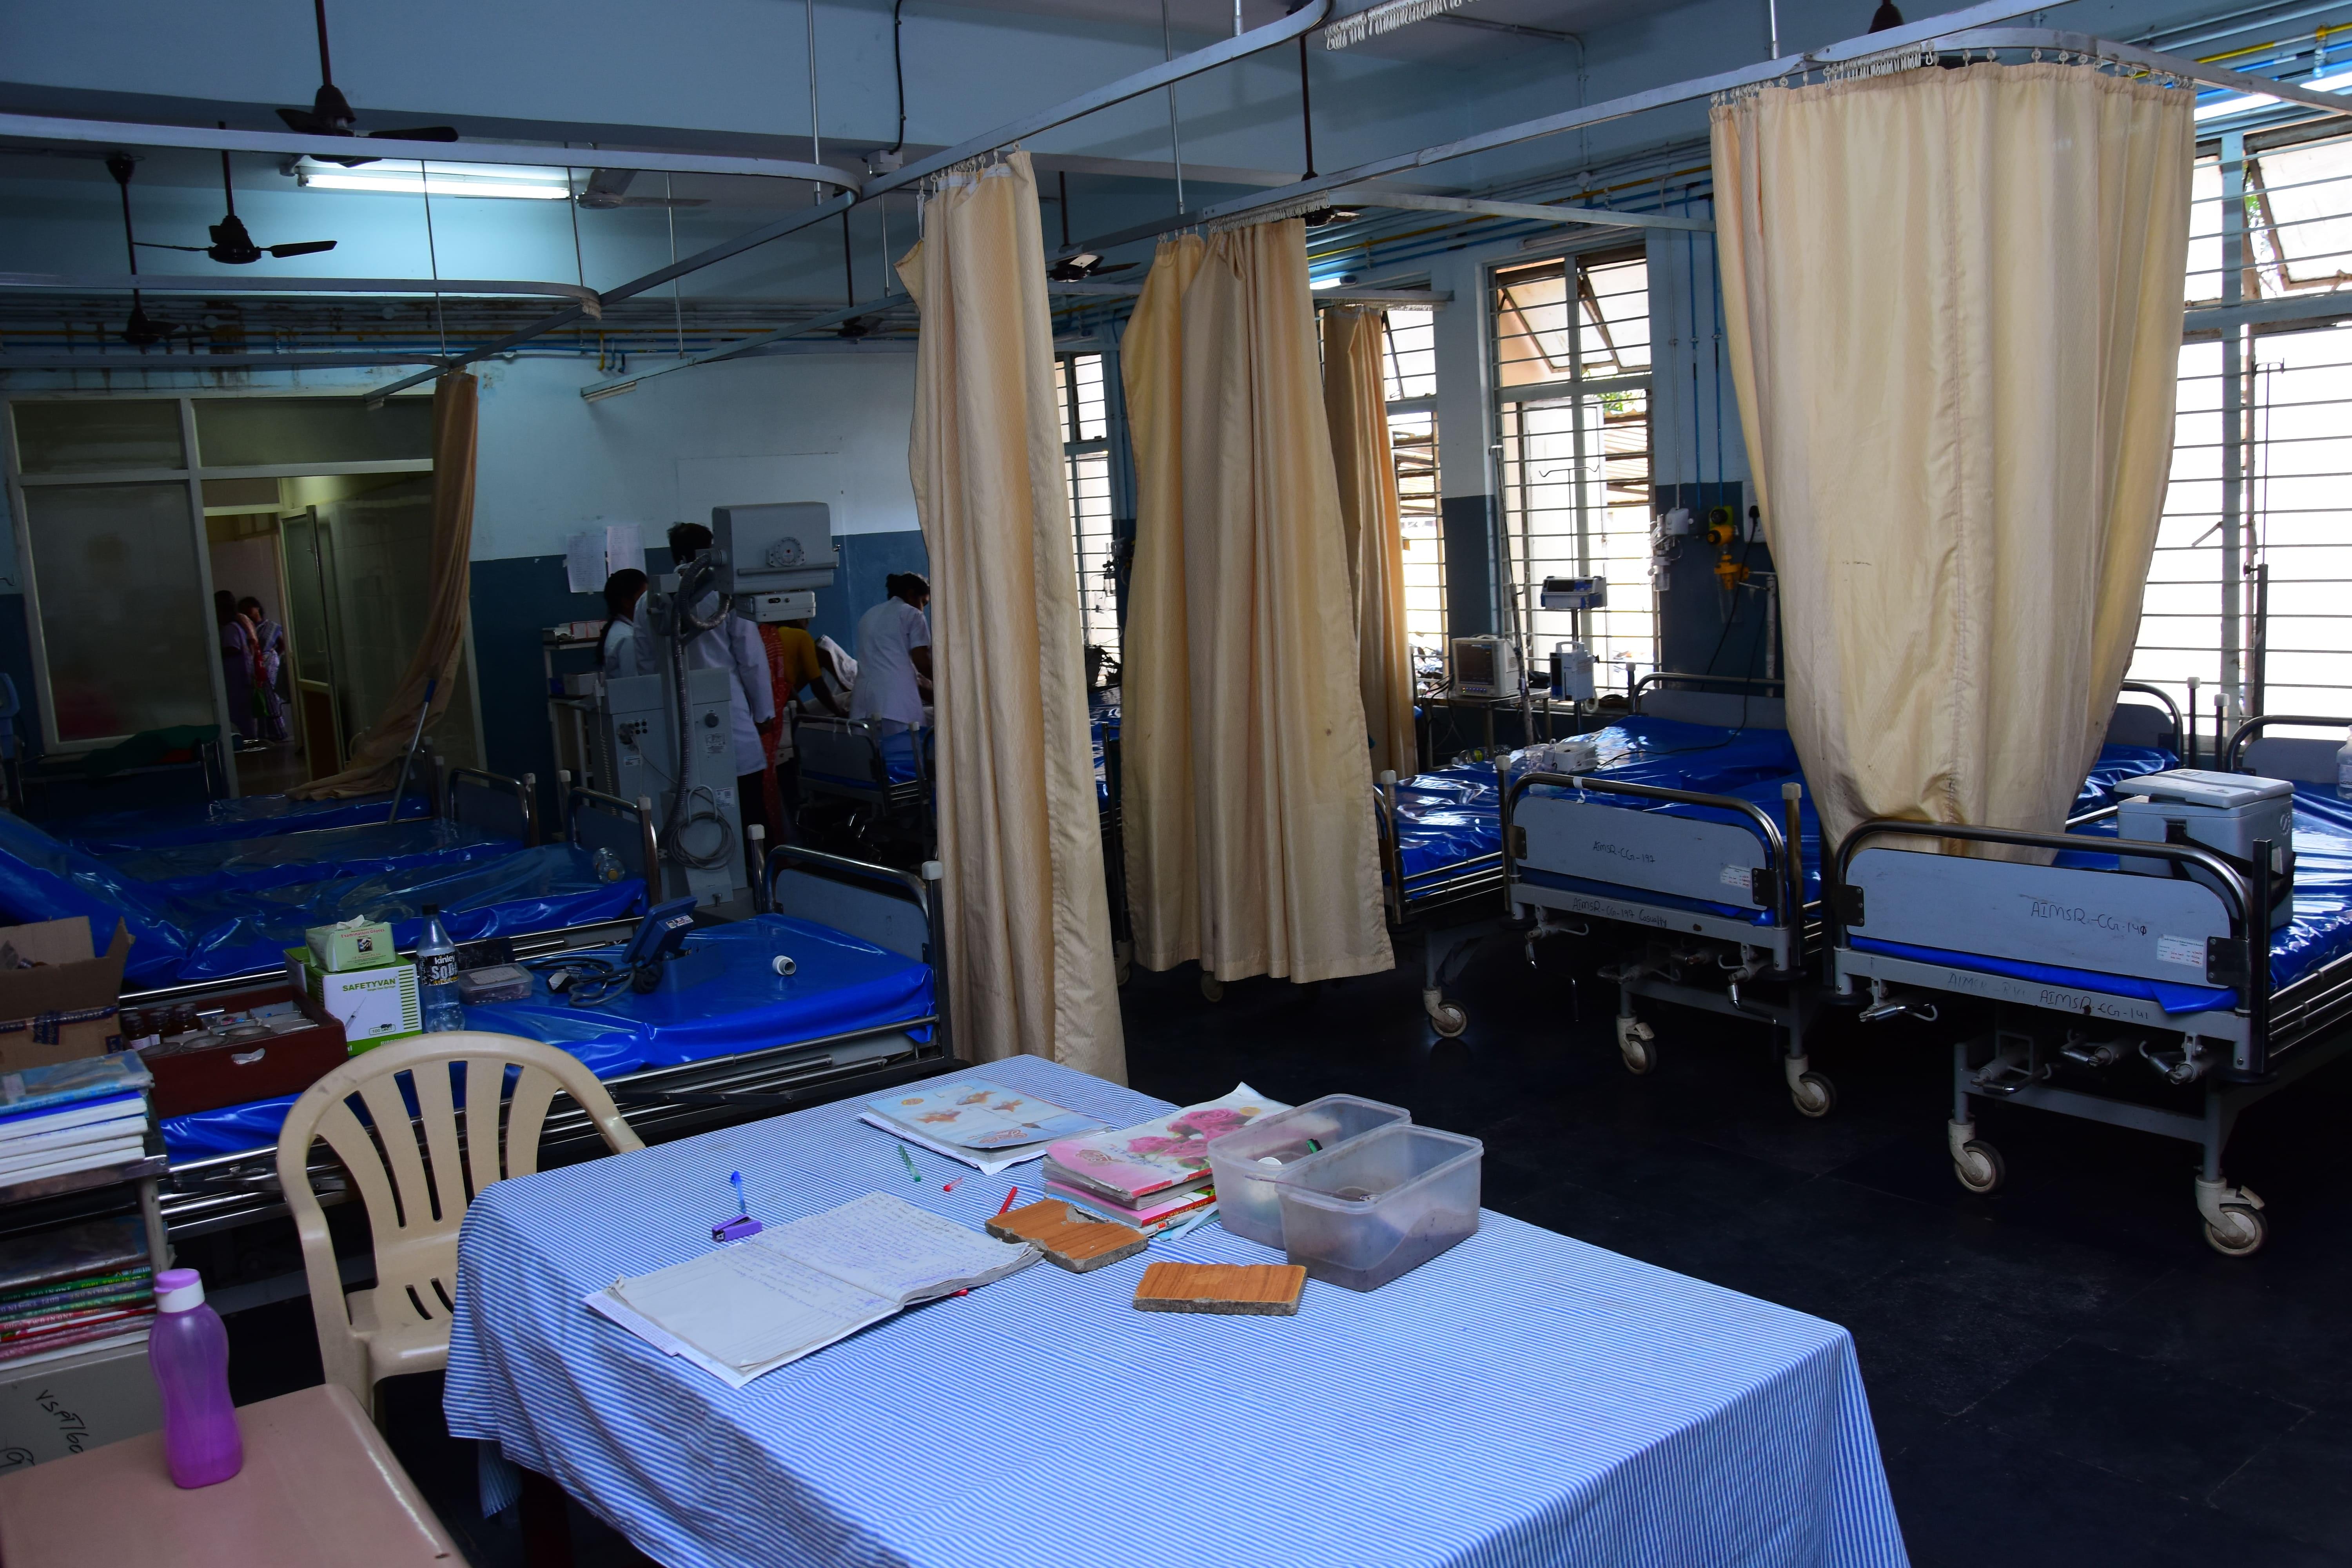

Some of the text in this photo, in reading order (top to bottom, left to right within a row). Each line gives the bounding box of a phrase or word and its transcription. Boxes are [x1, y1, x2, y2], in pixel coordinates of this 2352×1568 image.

[1639, 909, 1667, 927] Casualty
[434, 955, 455, 965] kinley
[343, 978, 396, 991] SAFETYVAN
